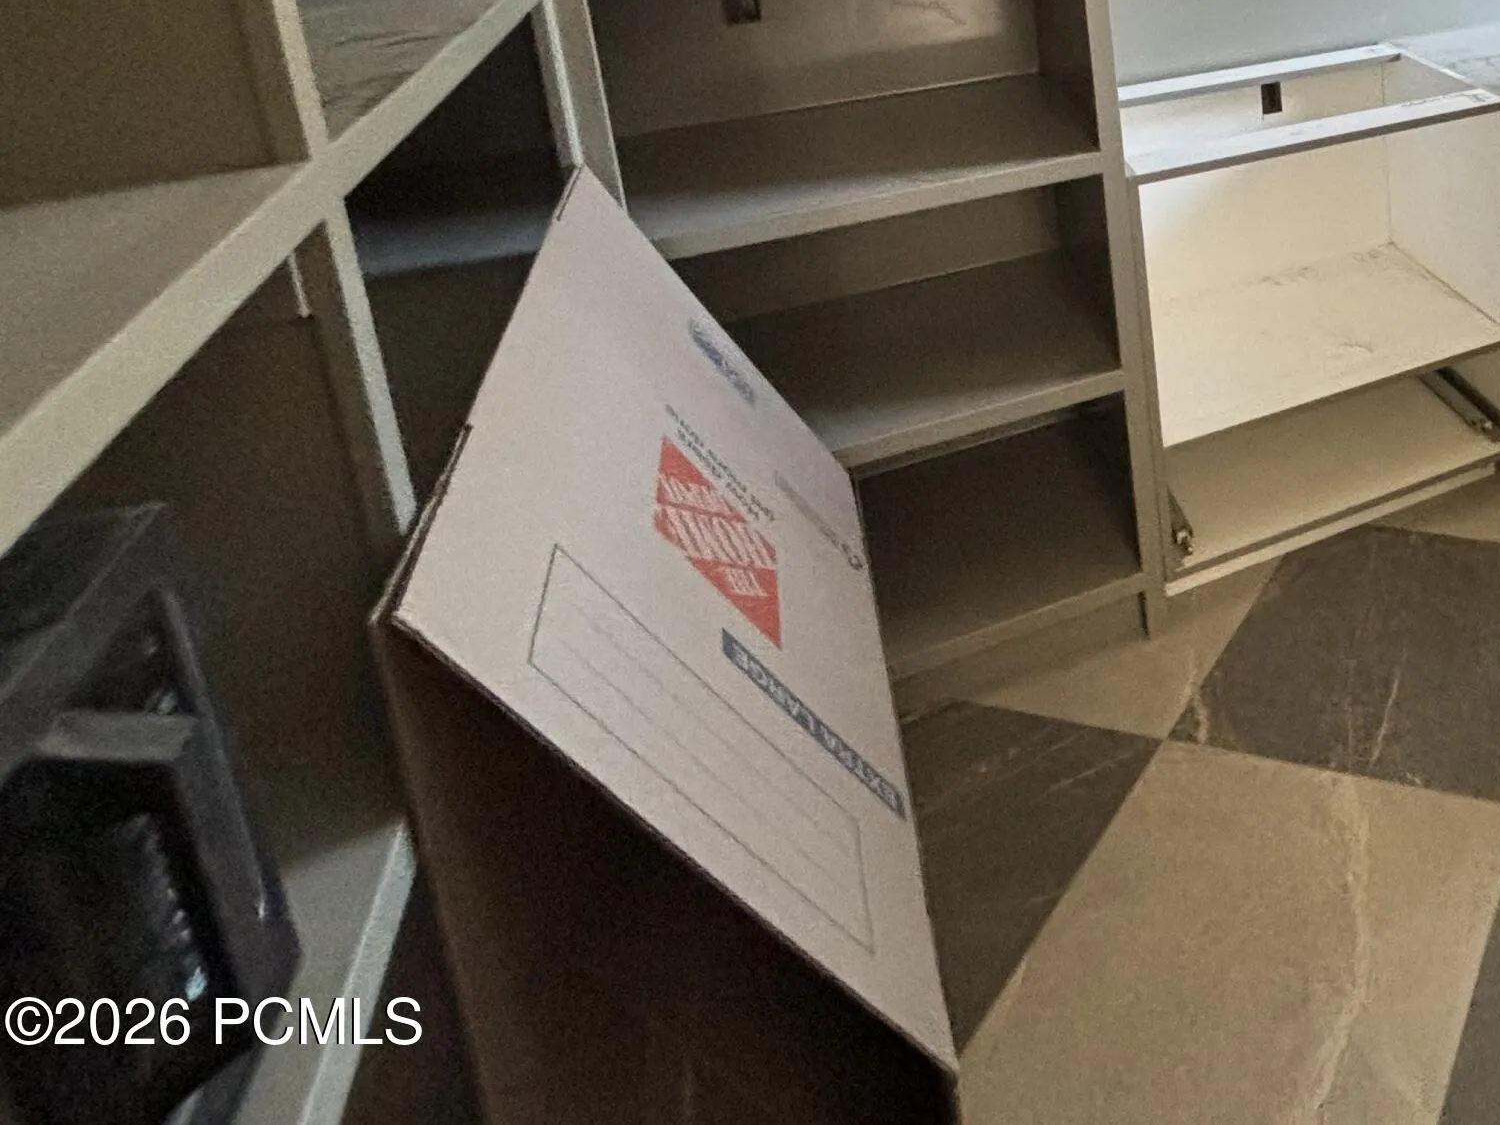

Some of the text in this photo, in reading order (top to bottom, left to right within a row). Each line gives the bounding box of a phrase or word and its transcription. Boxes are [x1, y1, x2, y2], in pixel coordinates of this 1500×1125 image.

[658, 500, 777, 571] HOME
[723, 566, 769, 596] THE
[730, 638, 899, 813] EXTRA LARGE
